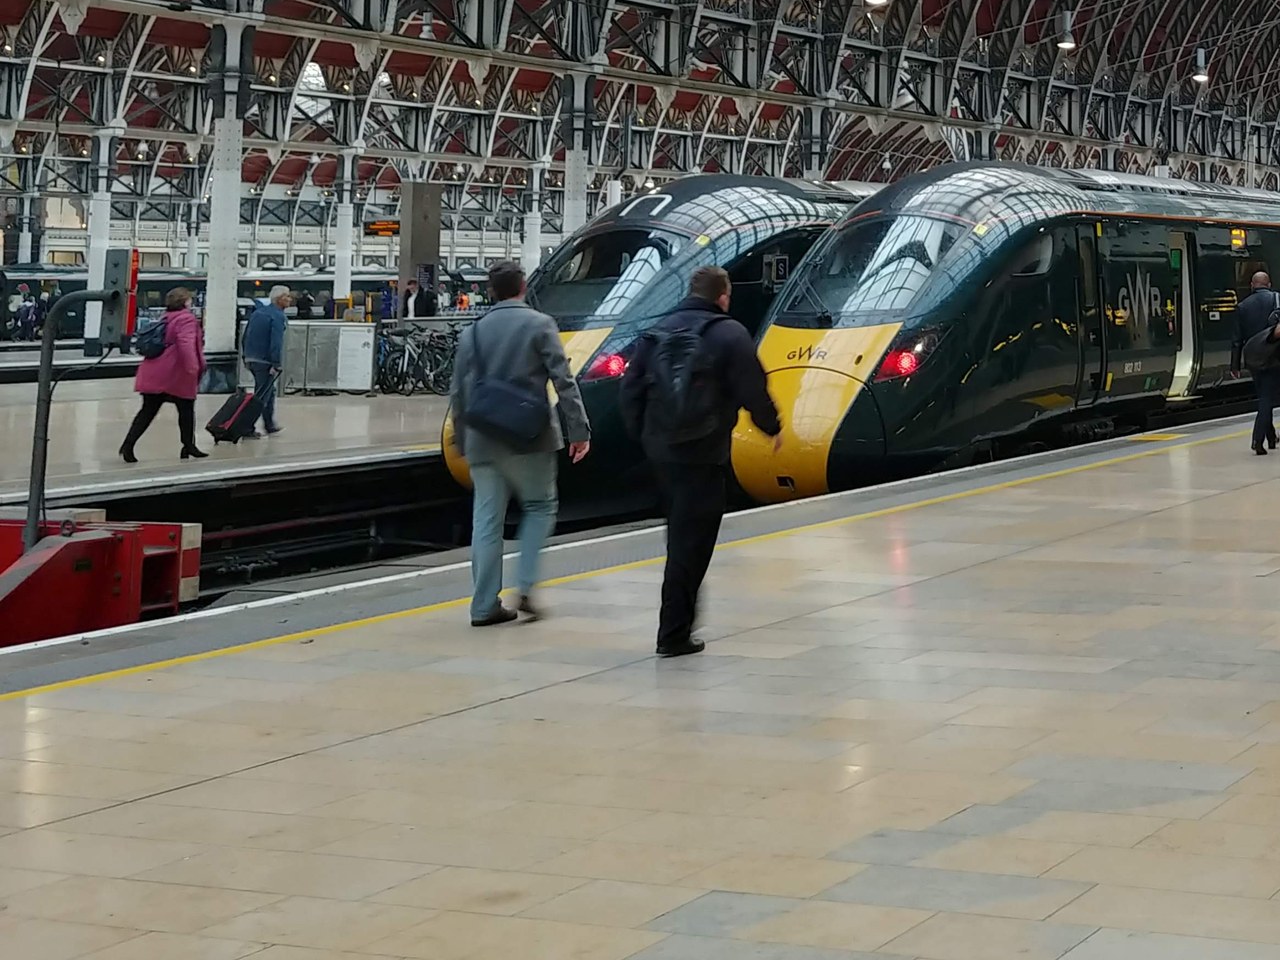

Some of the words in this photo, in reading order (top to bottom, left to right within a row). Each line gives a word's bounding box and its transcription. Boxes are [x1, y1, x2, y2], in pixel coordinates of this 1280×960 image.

[778, 263, 785, 275] S
[1119, 262, 1162, 327] GWR
[786, 344, 828, 361] GWR
